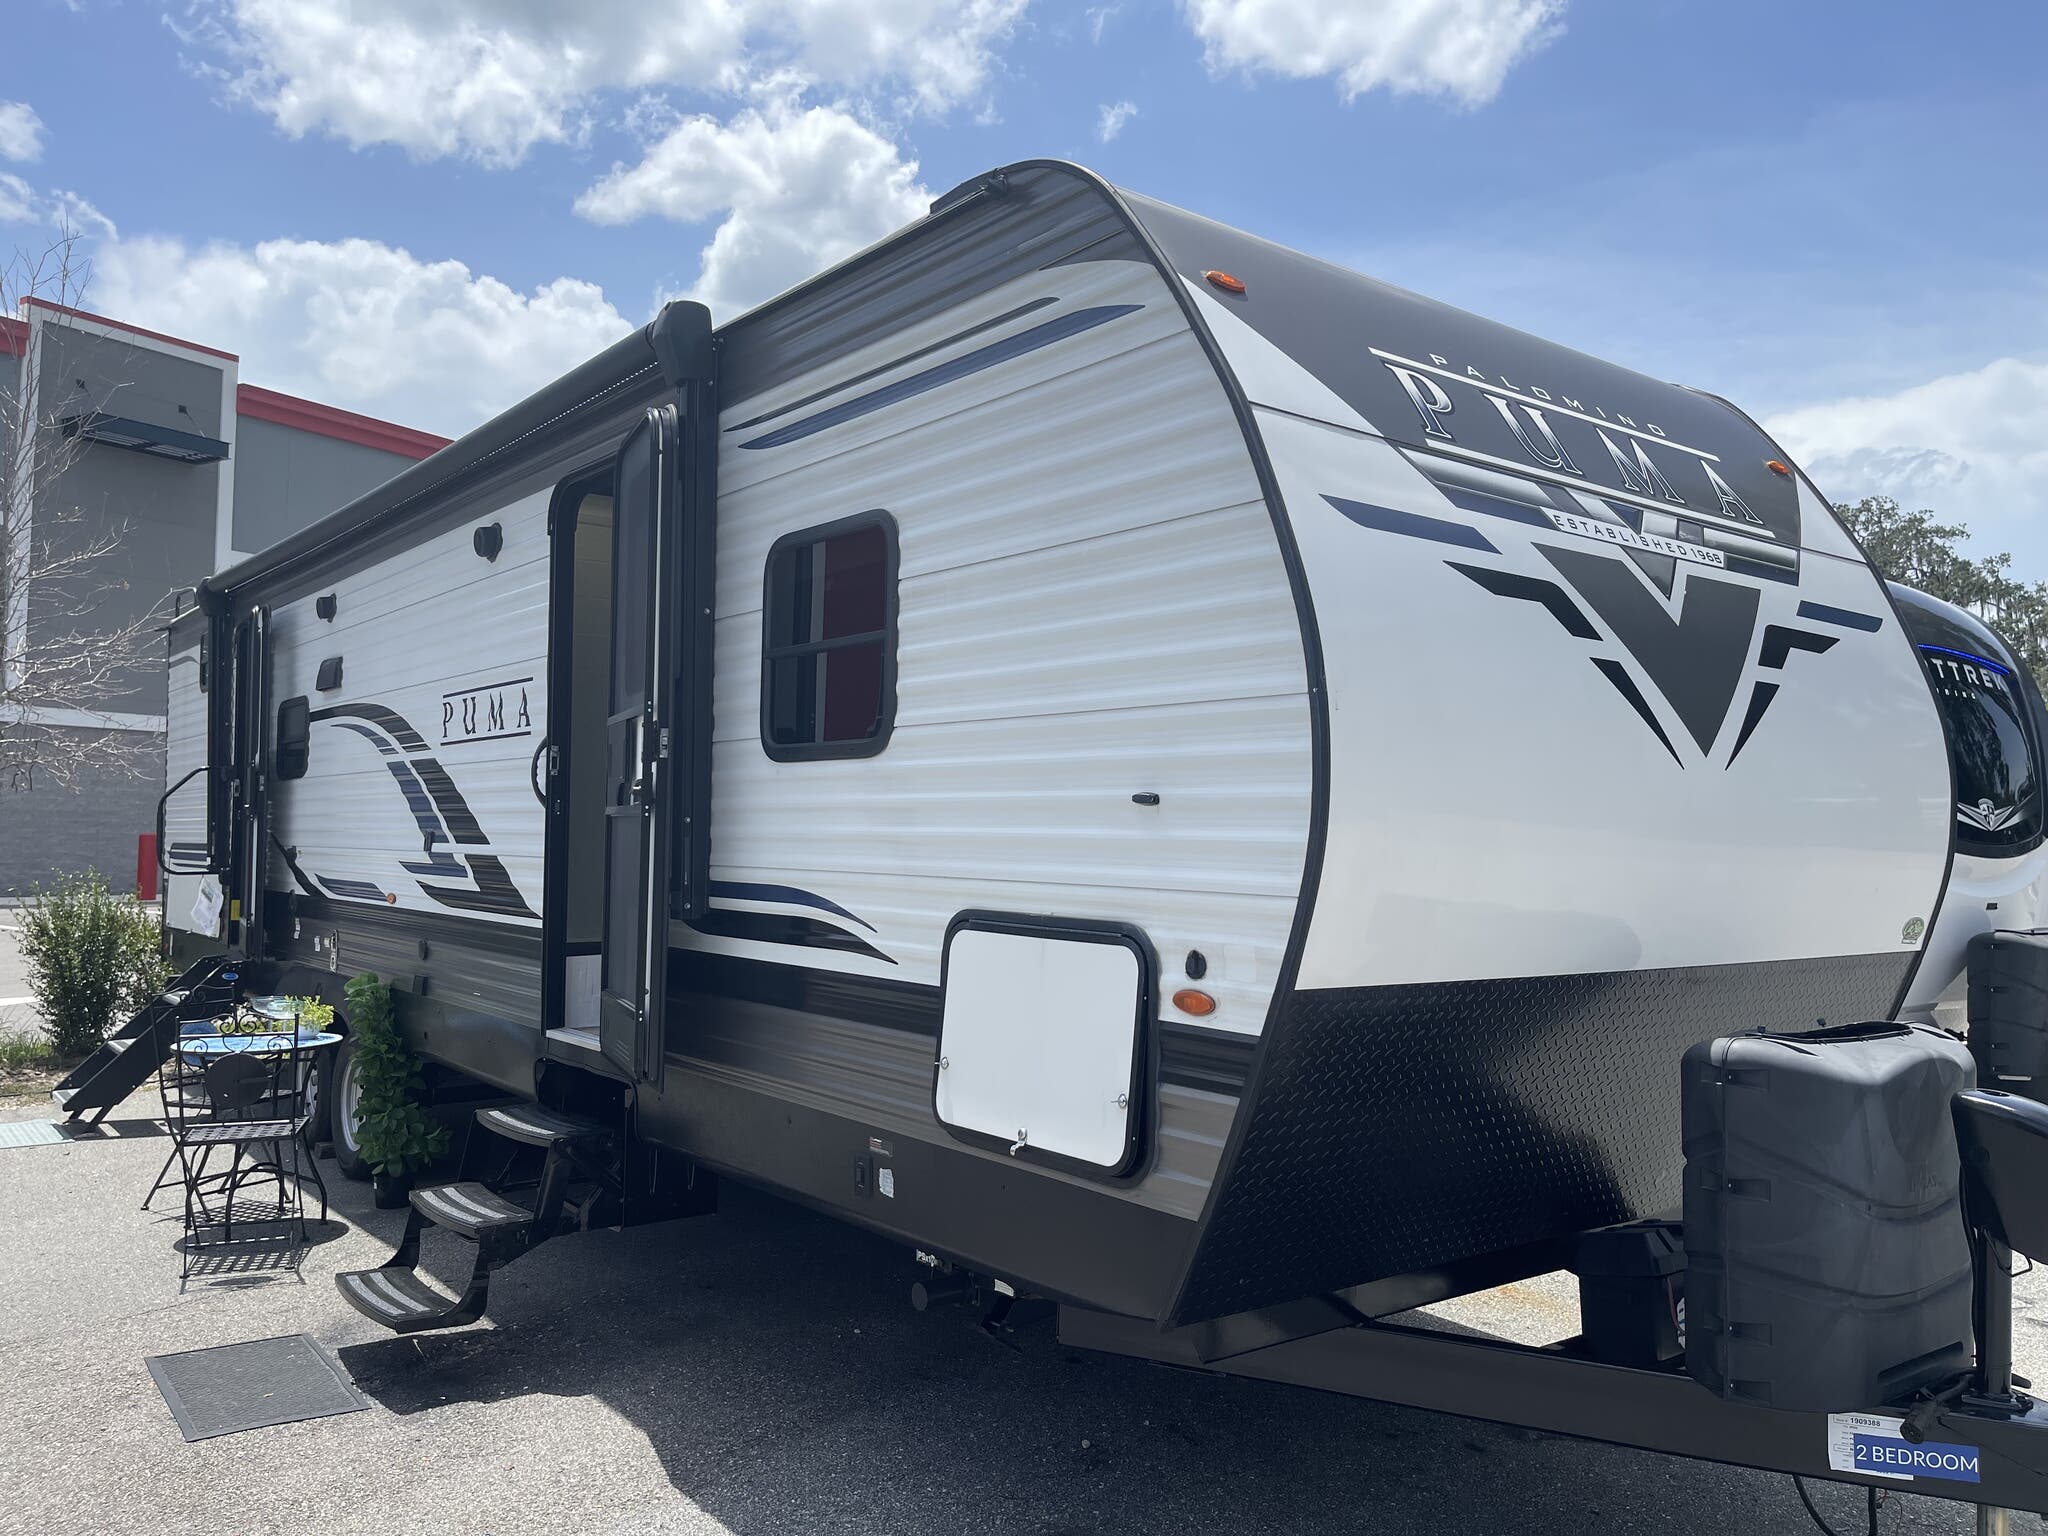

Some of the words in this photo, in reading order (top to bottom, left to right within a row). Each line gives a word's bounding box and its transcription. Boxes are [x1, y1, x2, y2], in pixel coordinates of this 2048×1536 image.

[1429, 353, 1666, 437] PALOMINO
[1384, 361, 1765, 526] PUMA
[1553, 514, 1688, 556] ESTABLISHED
[1691, 549, 1722, 564] 1968
[442, 686, 531, 738] PUMA
[1856, 1444, 1868, 1461] 2
[1872, 1445, 1979, 1473] BEDROOM
